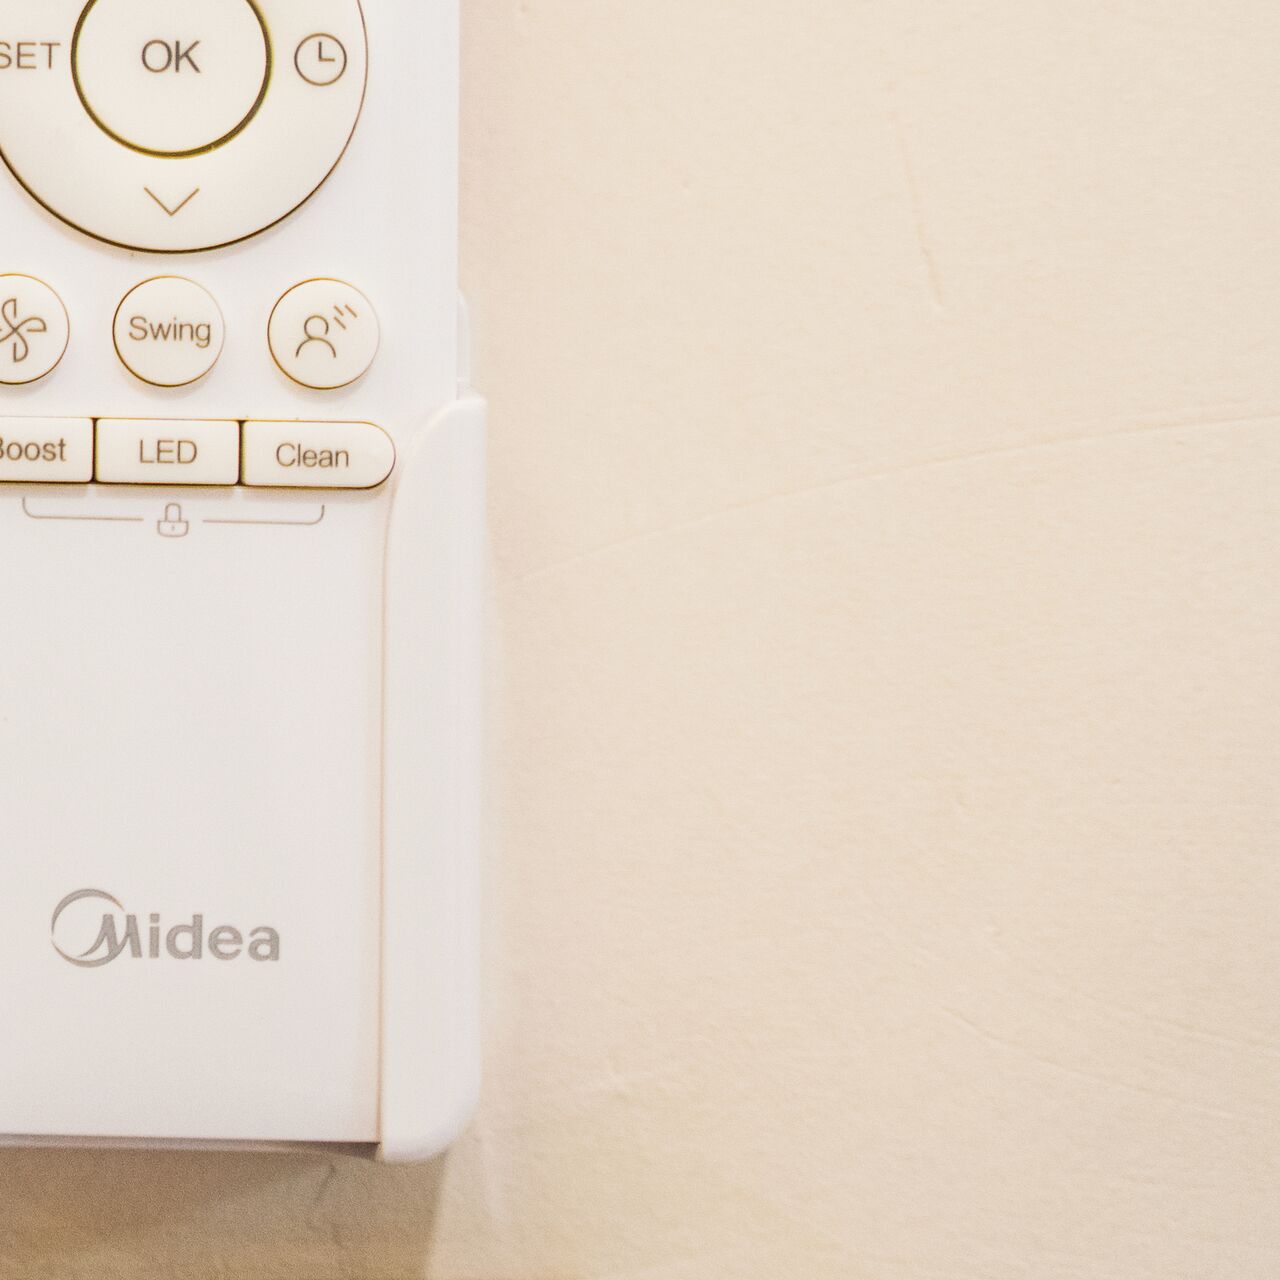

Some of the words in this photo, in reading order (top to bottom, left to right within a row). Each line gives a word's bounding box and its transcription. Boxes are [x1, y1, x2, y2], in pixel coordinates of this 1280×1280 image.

[140, 38, 202, 74] OK
[128, 315, 212, 349] Swing
[139, 438, 199, 465] LED
[274, 442, 351, 469] Clean
[50, 887, 281, 969] Midea
